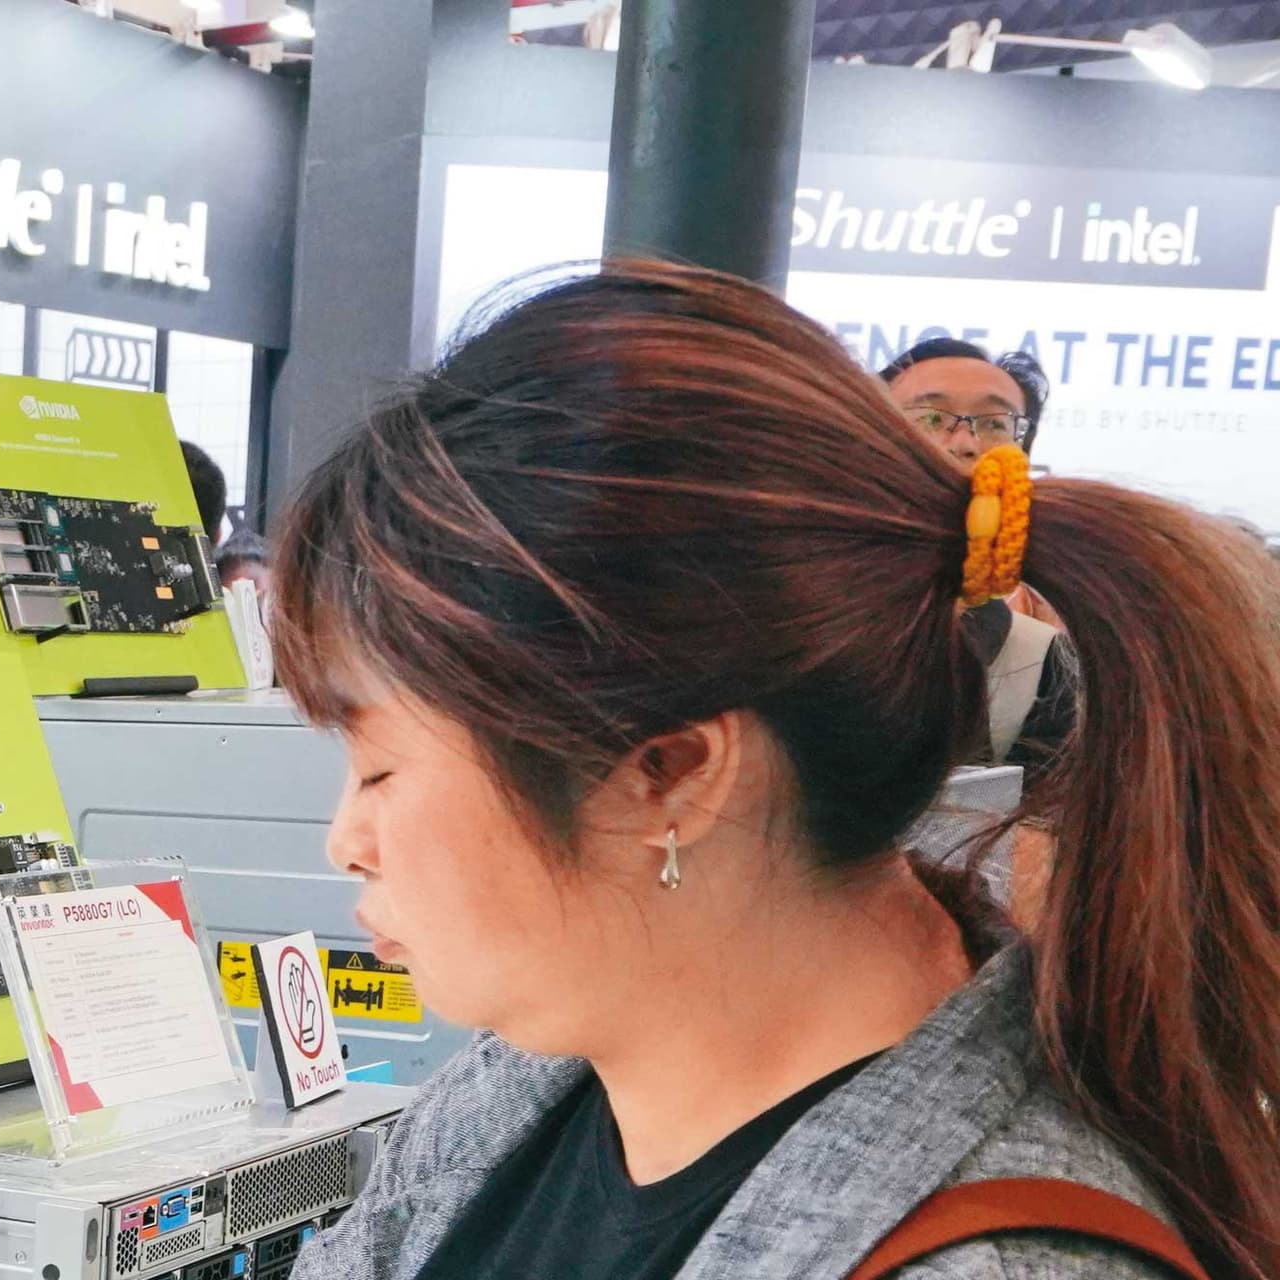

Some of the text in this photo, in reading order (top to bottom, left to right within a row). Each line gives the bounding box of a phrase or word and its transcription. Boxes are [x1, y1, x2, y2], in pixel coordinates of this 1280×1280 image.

[1106, 333, 1214, 389] THE
[63, 898, 142, 923] P5880G7 (LC)
[296, 1061, 340, 1093] No Touch
